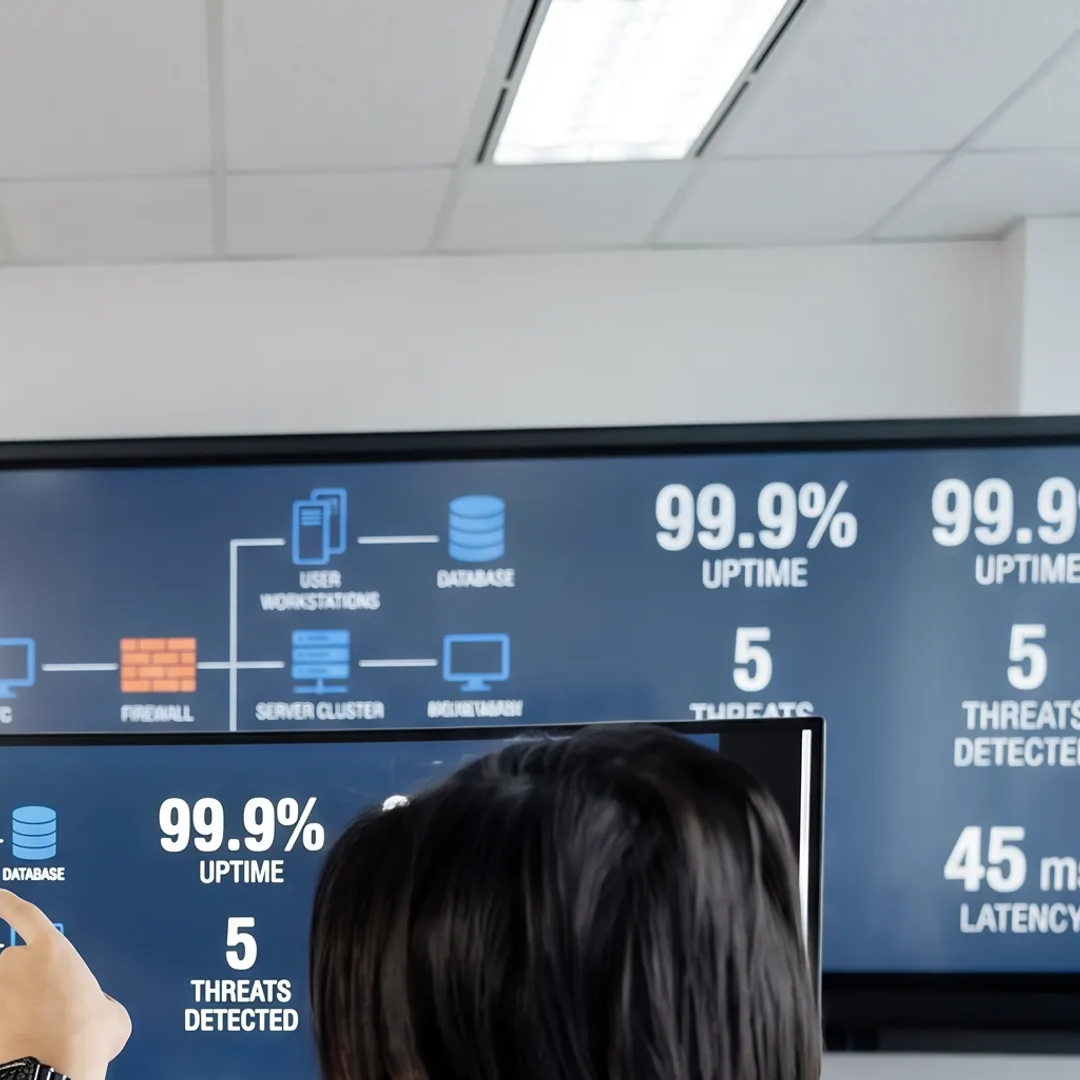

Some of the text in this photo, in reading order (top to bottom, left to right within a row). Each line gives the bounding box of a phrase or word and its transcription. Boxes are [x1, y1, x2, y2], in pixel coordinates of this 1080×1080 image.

[656, 481, 858, 552] 99.9%
[931, 476, 1080, 547] 99.9
[299, 570, 342, 589] USER
[436, 568, 515, 589] DATABASE
[702, 557, 808, 589] UPTIME
[975, 553, 1080, 586] UPTIME
[259, 591, 381, 611] WORKSTATIONS
[733, 627, 773, 692] 5
[1007, 623, 1048, 690] 5
[120, 704, 195, 723] FIREWALL
[255, 700, 385, 721] SERVER CLUSTER
[953, 736, 1080, 767] DETECTE
[158, 796, 325, 853] 99.9%
[2, 866, 66, 881] DATABASE
[199, 859, 285, 884] UPTIME
[943, 826, 1080, 893] 45 m
[225, 916, 258, 971] 5
[190, 979, 292, 1003] THREATS
[184, 1008, 299, 1032] DETECTED
